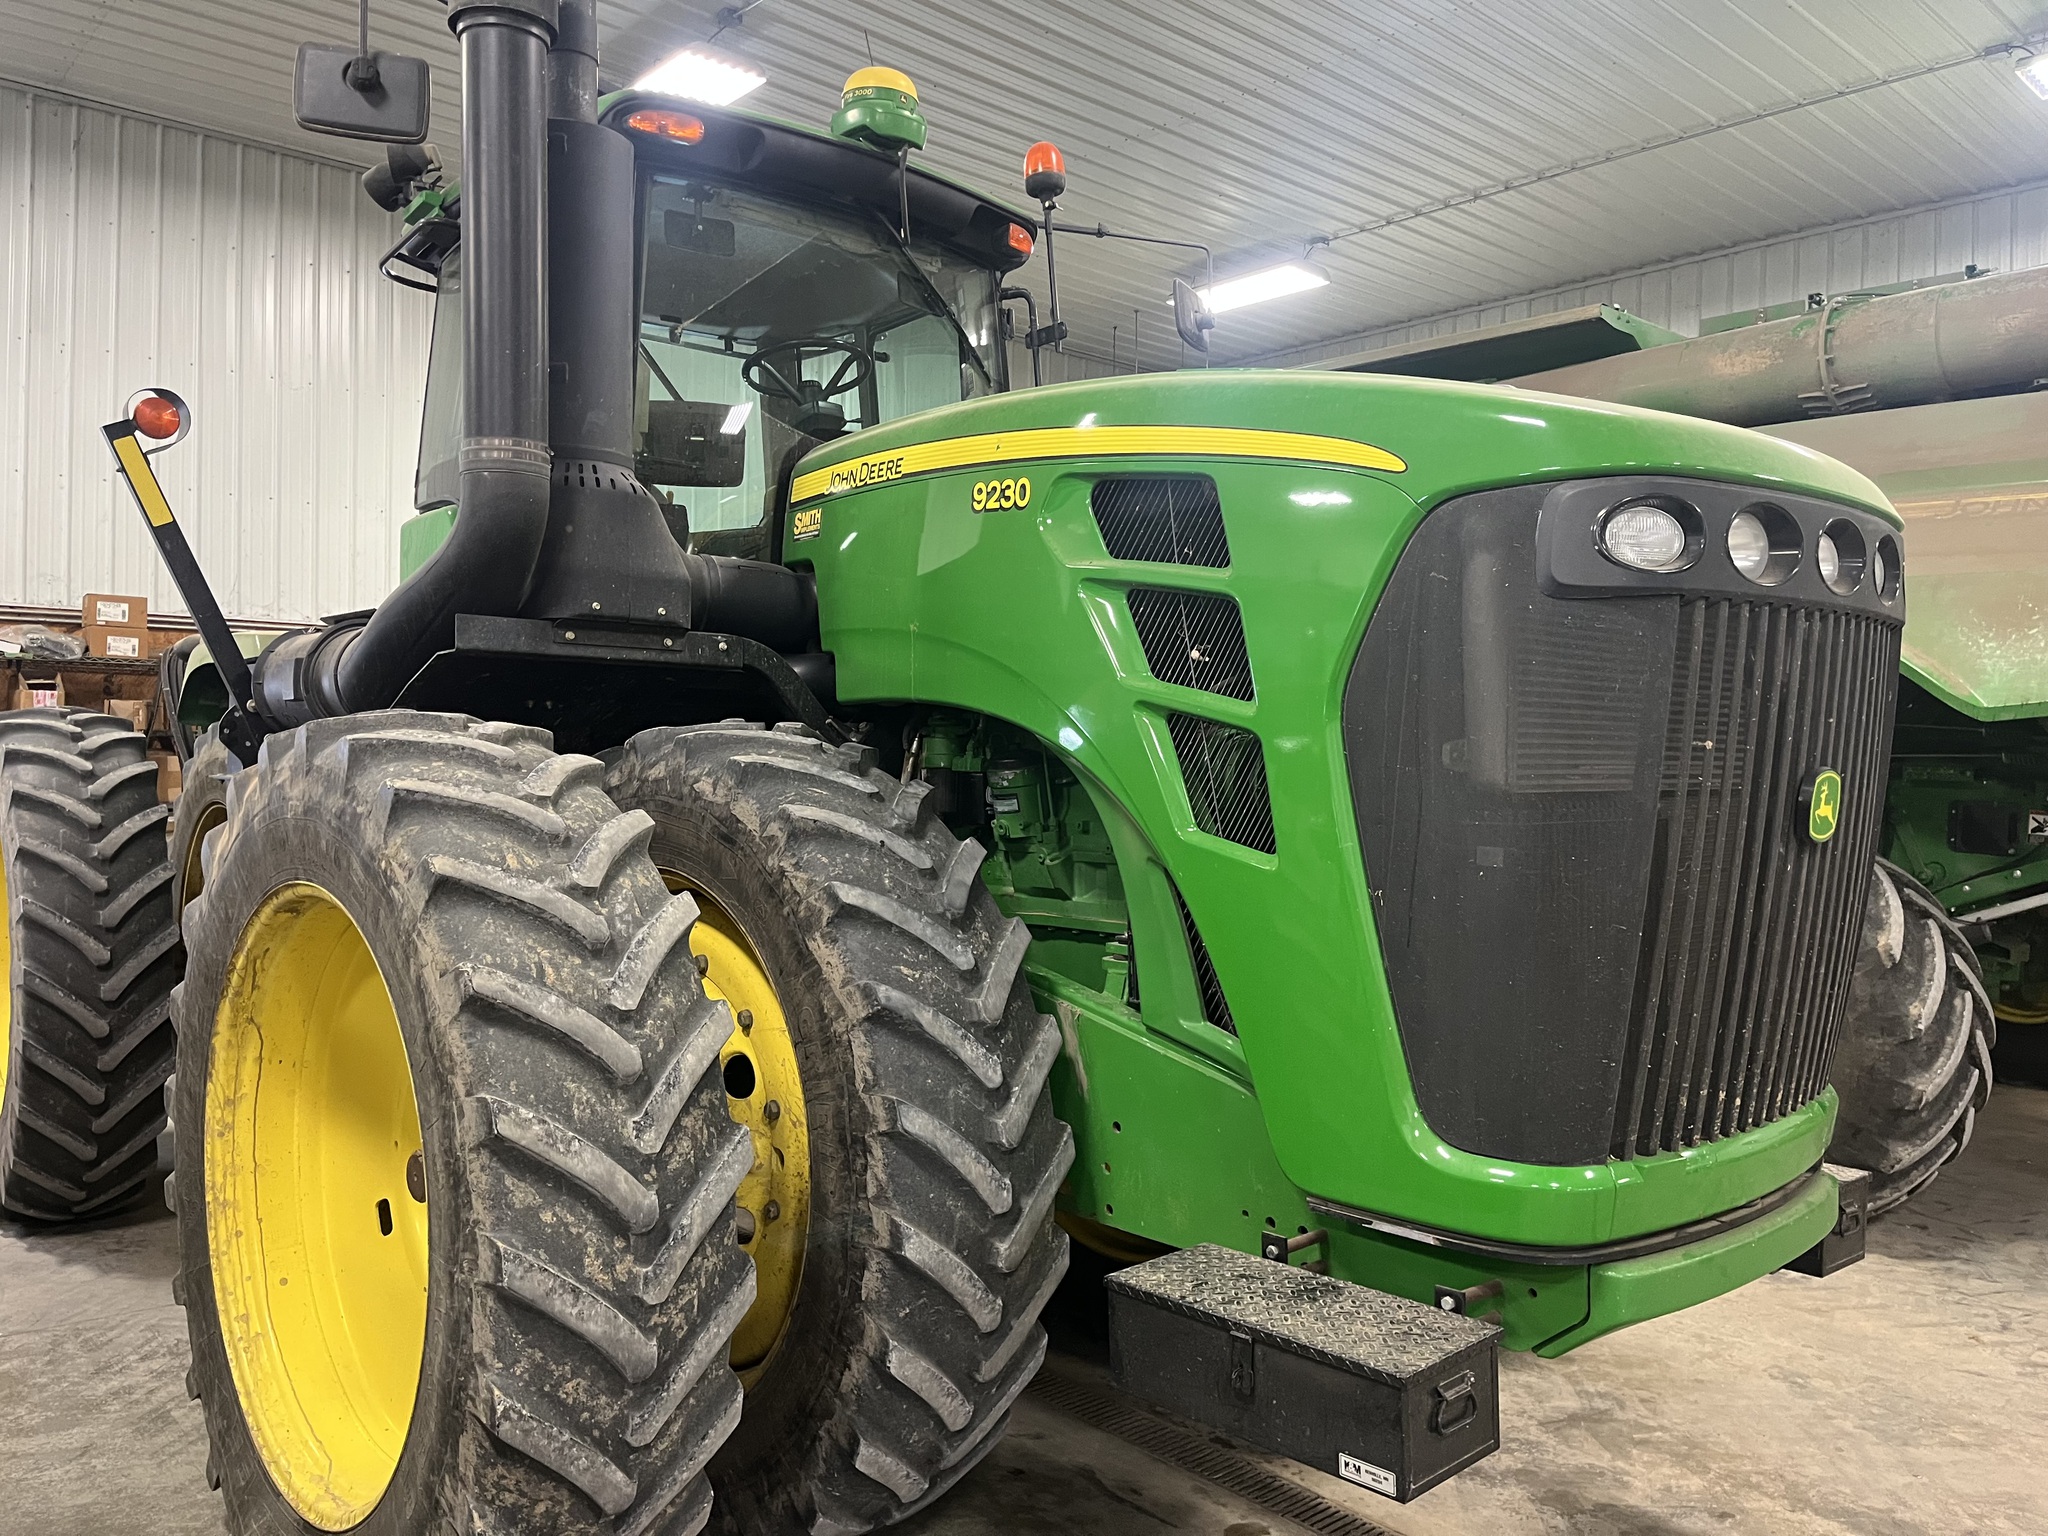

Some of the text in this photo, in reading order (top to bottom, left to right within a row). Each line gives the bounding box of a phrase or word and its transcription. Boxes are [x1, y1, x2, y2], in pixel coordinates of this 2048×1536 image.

[854, 88, 873, 97] 3000
[826, 457, 904, 492] JOHN DEERE
[972, 477, 1031, 512] 9230
[794, 508, 822, 535] SMITH
